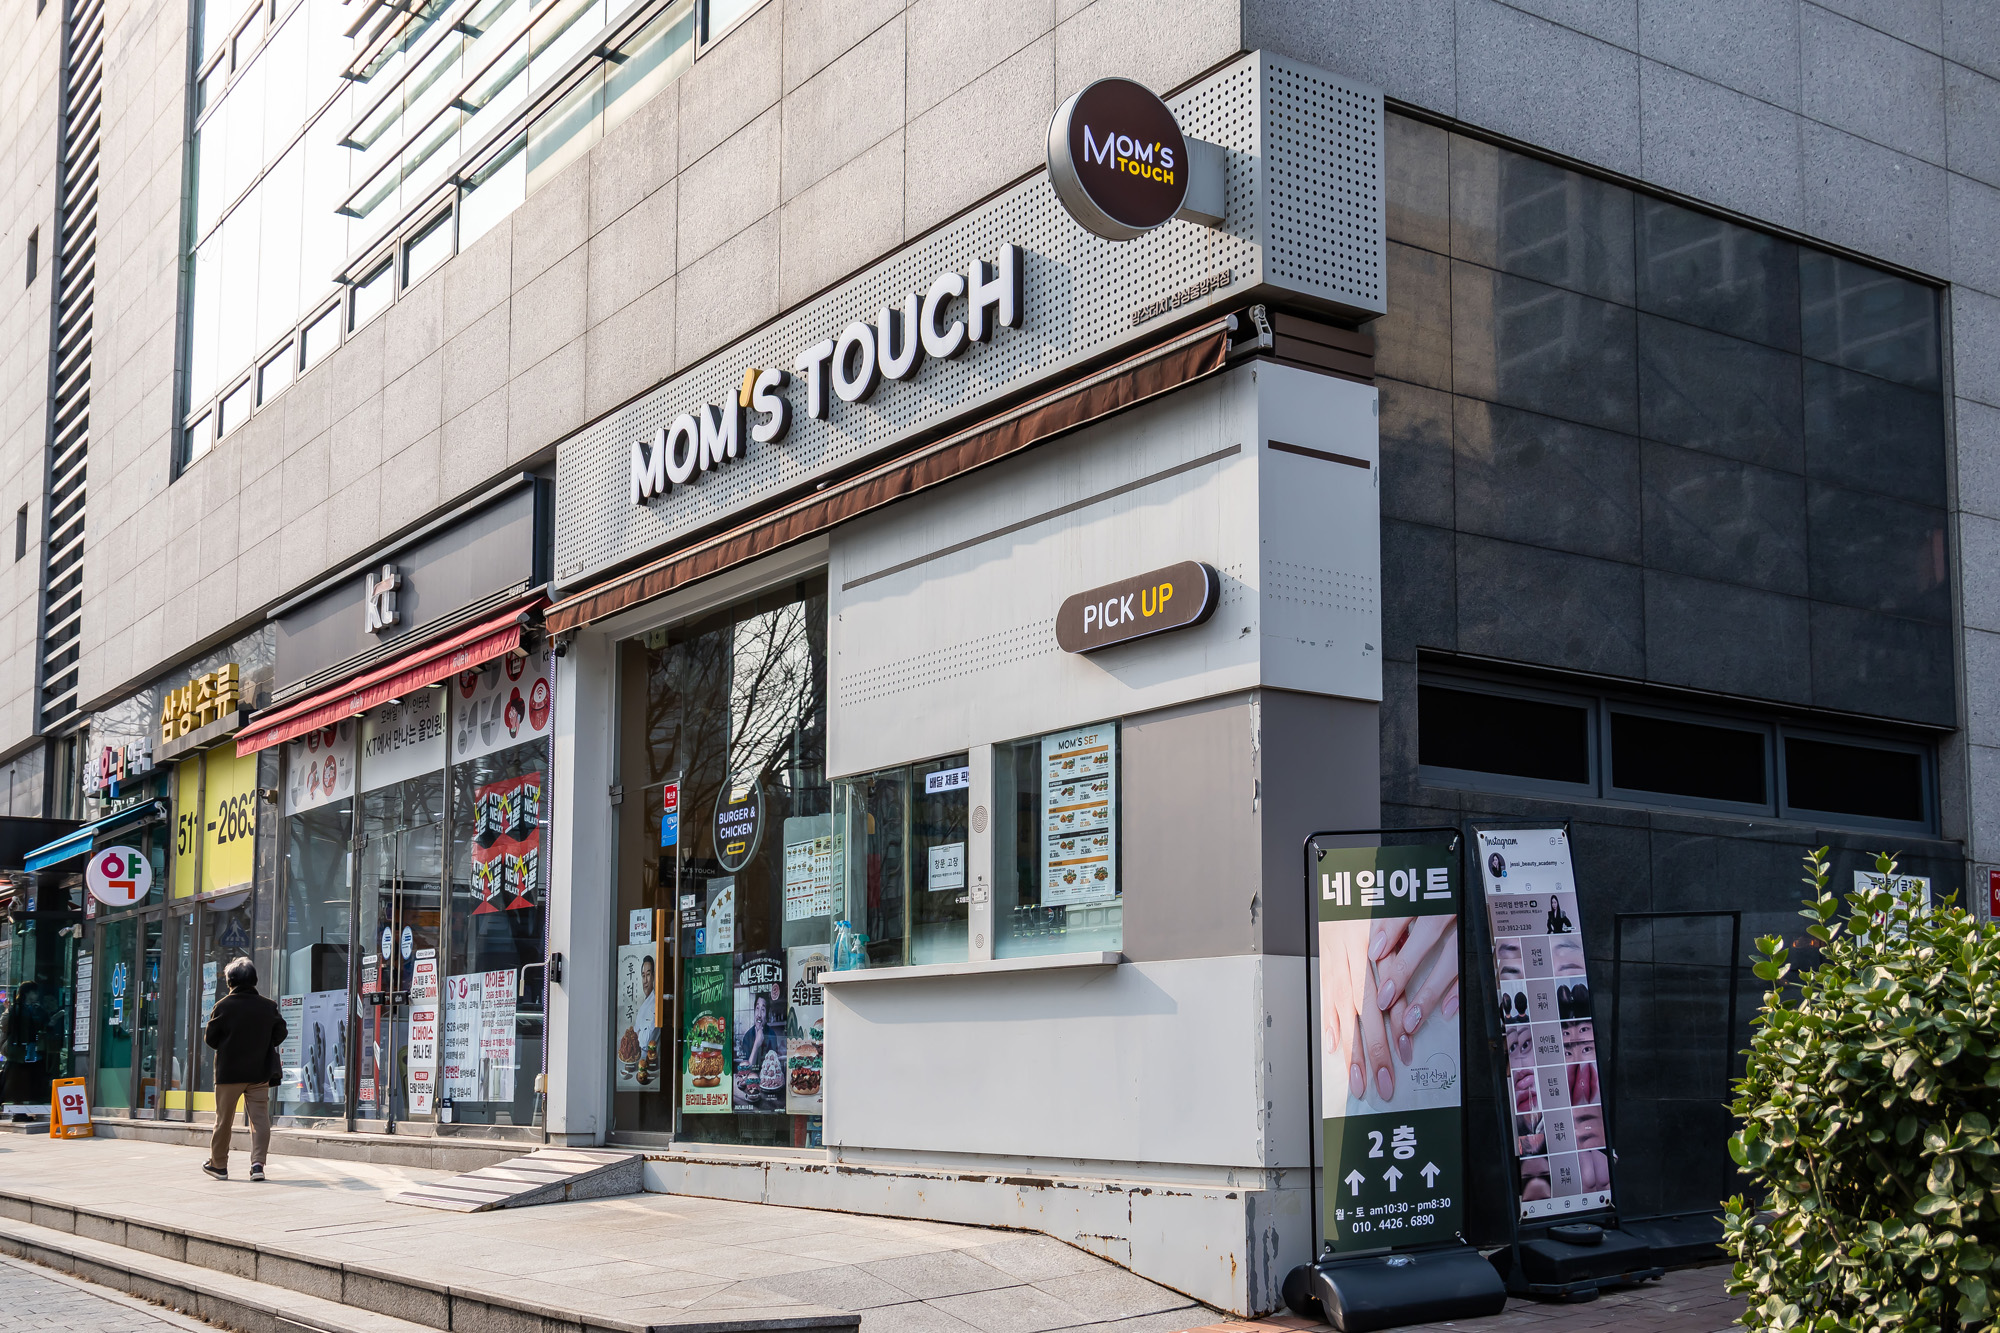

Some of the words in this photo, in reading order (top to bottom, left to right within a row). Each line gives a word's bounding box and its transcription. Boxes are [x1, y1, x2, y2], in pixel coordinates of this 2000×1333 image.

[1084, 124, 1174, 169] MOM'S
[1117, 156, 1174, 185] TOUCH
[630, 367, 791, 506] MOM'S
[795, 242, 1024, 421] TOUCH
[364, 563, 401, 635] kt
[1083, 592, 1136, 634] PICK
[1141, 582, 1174, 618] UP
[161, 662, 240, 745] 삼성주류
[393, 722, 417, 751] 만나는
[1058, 736, 1083, 751] MOM'S
[1083, 734, 1099, 746] SET
[929, 775, 944, 789] 배달
[944, 772, 959, 786] 제품
[961, 770, 970, 783] 픽
[488, 806, 504, 824] NEW
[524, 798, 539, 815] NEW
[718, 807, 749, 825] BURGER
[749, 806, 756, 818] &
[178, 811, 198, 857] 51
[720, 821, 753, 840] CHICKEN
[1484, 836, 1518, 850] Instagram
[934, 858, 946, 870] 창문
[947, 856, 959, 868] 고장
[100, 852, 142, 900] 약
[471, 873, 485, 891] NEW
[504, 867, 520, 885] NEW
[1321, 867, 1452, 907] 네일아트
[1494, 900, 1513, 909] 프리미엄
[485, 970, 505, 988] 아이폰
[506, 970, 515, 986] 17
[691, 973, 711, 994] BACK
[112, 962, 127, 1023] 약
[625, 962, 636, 1023] 후덕죽
[699, 982, 725, 1006] TOUCH
[792, 986, 825, 1007] 직화불
[412, 1025, 434, 1041] 디바이스
[1539, 1034, 1556, 1044] 아이돌
[413, 1044, 424, 1059] 하나
[1539, 1044, 1560, 1055] 메이크업
[1549, 1087, 1560, 1097] 입술
[62, 1093, 84, 1115] 약
[1335, 1208, 1345, 1221] 월
[1355, 1206, 1366, 1218] 토
[1369, 1202, 1409, 1216] am10:30
[1417, 1197, 1451, 1213] pm8:30
[1352, 1221, 1371, 1234] 010
[1378, 1217, 1403, 1231] 4426
[1410, 1214, 1435, 1228] 6890
